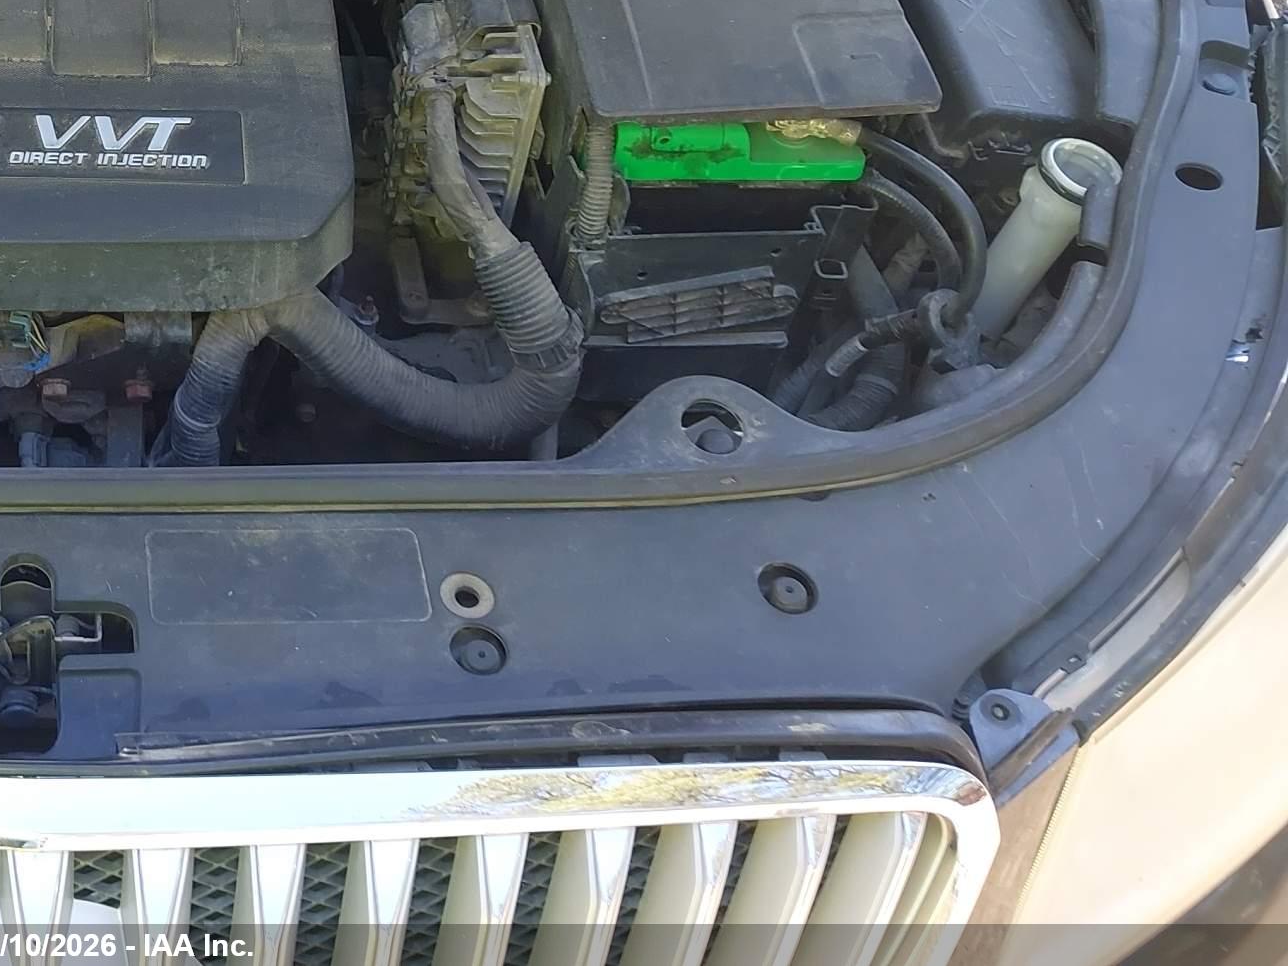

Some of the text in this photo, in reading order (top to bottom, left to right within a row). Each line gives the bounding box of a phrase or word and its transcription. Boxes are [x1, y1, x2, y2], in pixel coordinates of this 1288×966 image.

[35, 115, 192, 151] VVT
[9, 152, 208, 169] DIRECT INJECTION
